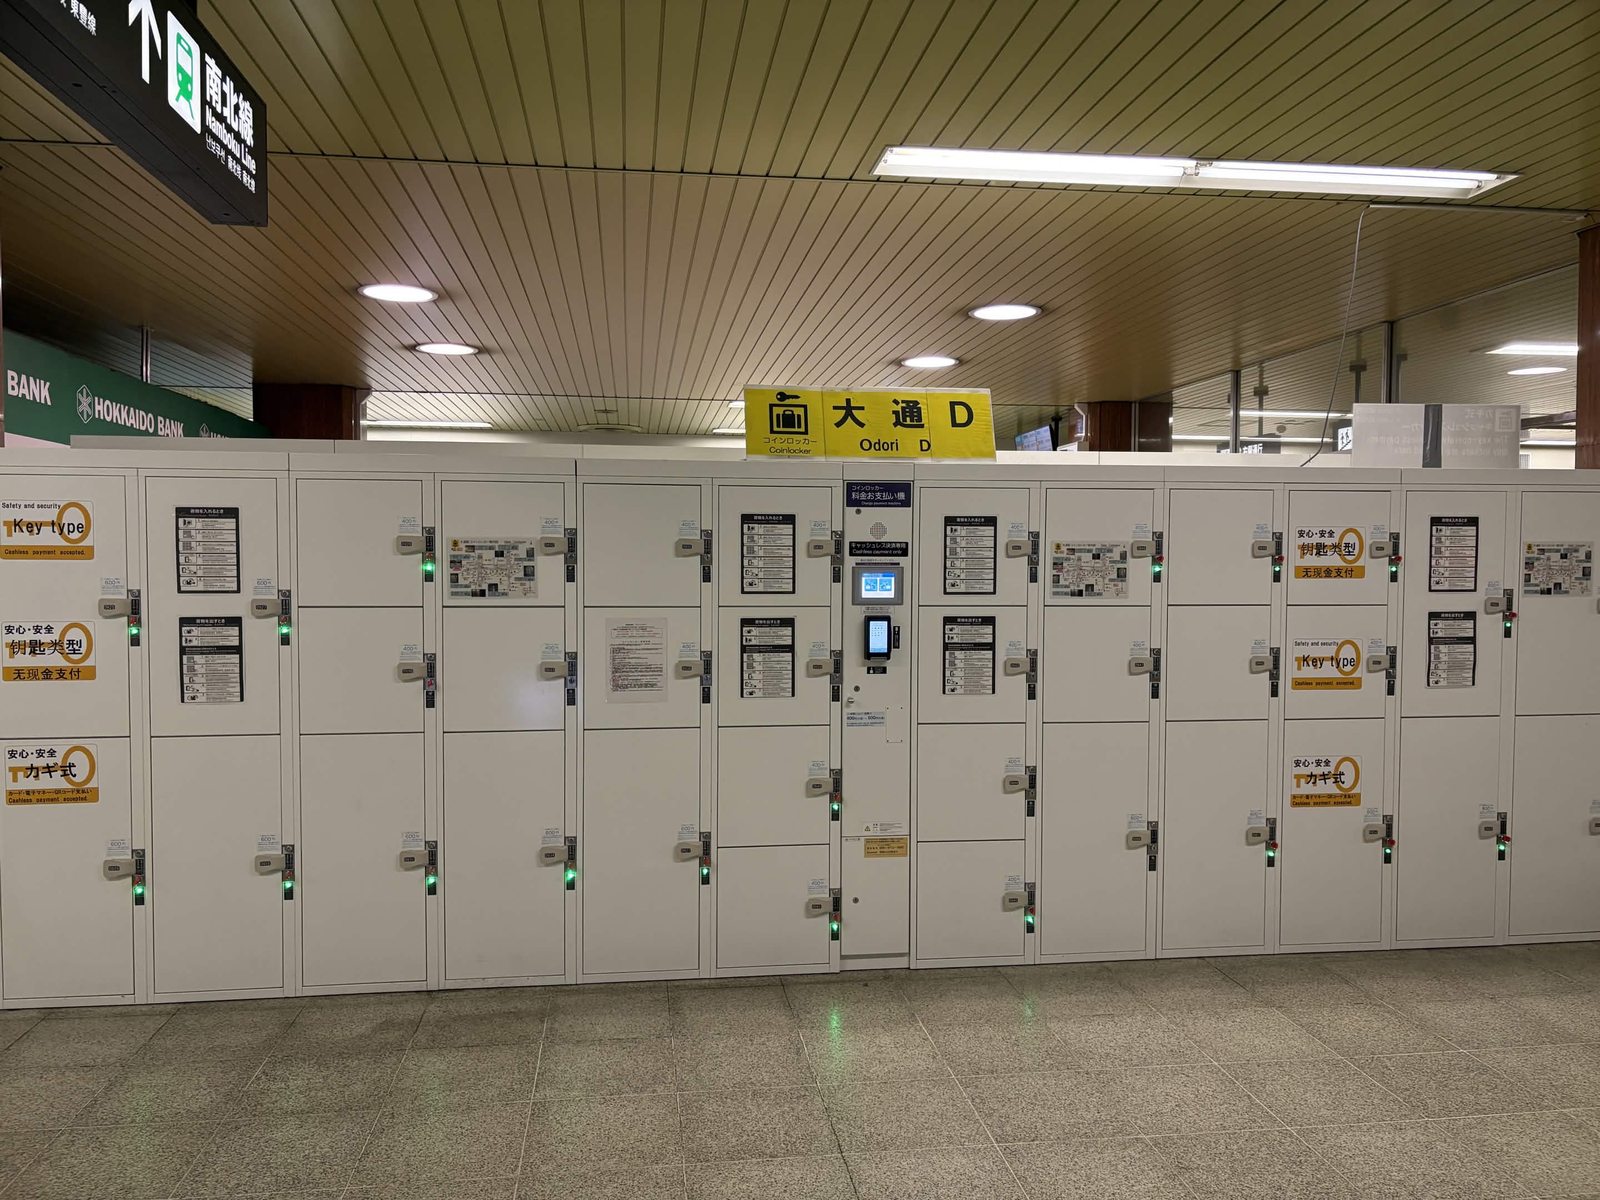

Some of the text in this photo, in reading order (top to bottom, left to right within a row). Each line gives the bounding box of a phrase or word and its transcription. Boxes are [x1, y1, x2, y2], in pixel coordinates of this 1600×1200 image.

[205, 53, 254, 148] 南北線
[206, 105, 257, 175] Namboku Line
[7, 369, 52, 406] BANK
[94, 396, 184, 438] HOKKAIDO BANK
[949, 400, 974, 429] D
[763, 437, 818, 445] コインロッカー
[859, 438, 932, 452] Odori D
[769, 446, 812, 455] Coinlocker
[851, 491, 906, 500] 料金お支払い機
[2, 502, 21, 510] Safety
[37, 502, 61, 510] security
[13, 518, 85, 536] Key type
[1301, 541, 1356, 557] 钥匙类型
[1302, 567, 1354, 578] 无现金支付
[10, 638, 83, 656] 钥匙类型
[1302, 654, 1356, 669] Key type
[13, 668, 82, 680] 无现金支付
[25, 762, 77, 779] カギ式
[1306, 771, 1345, 785] カギ式
